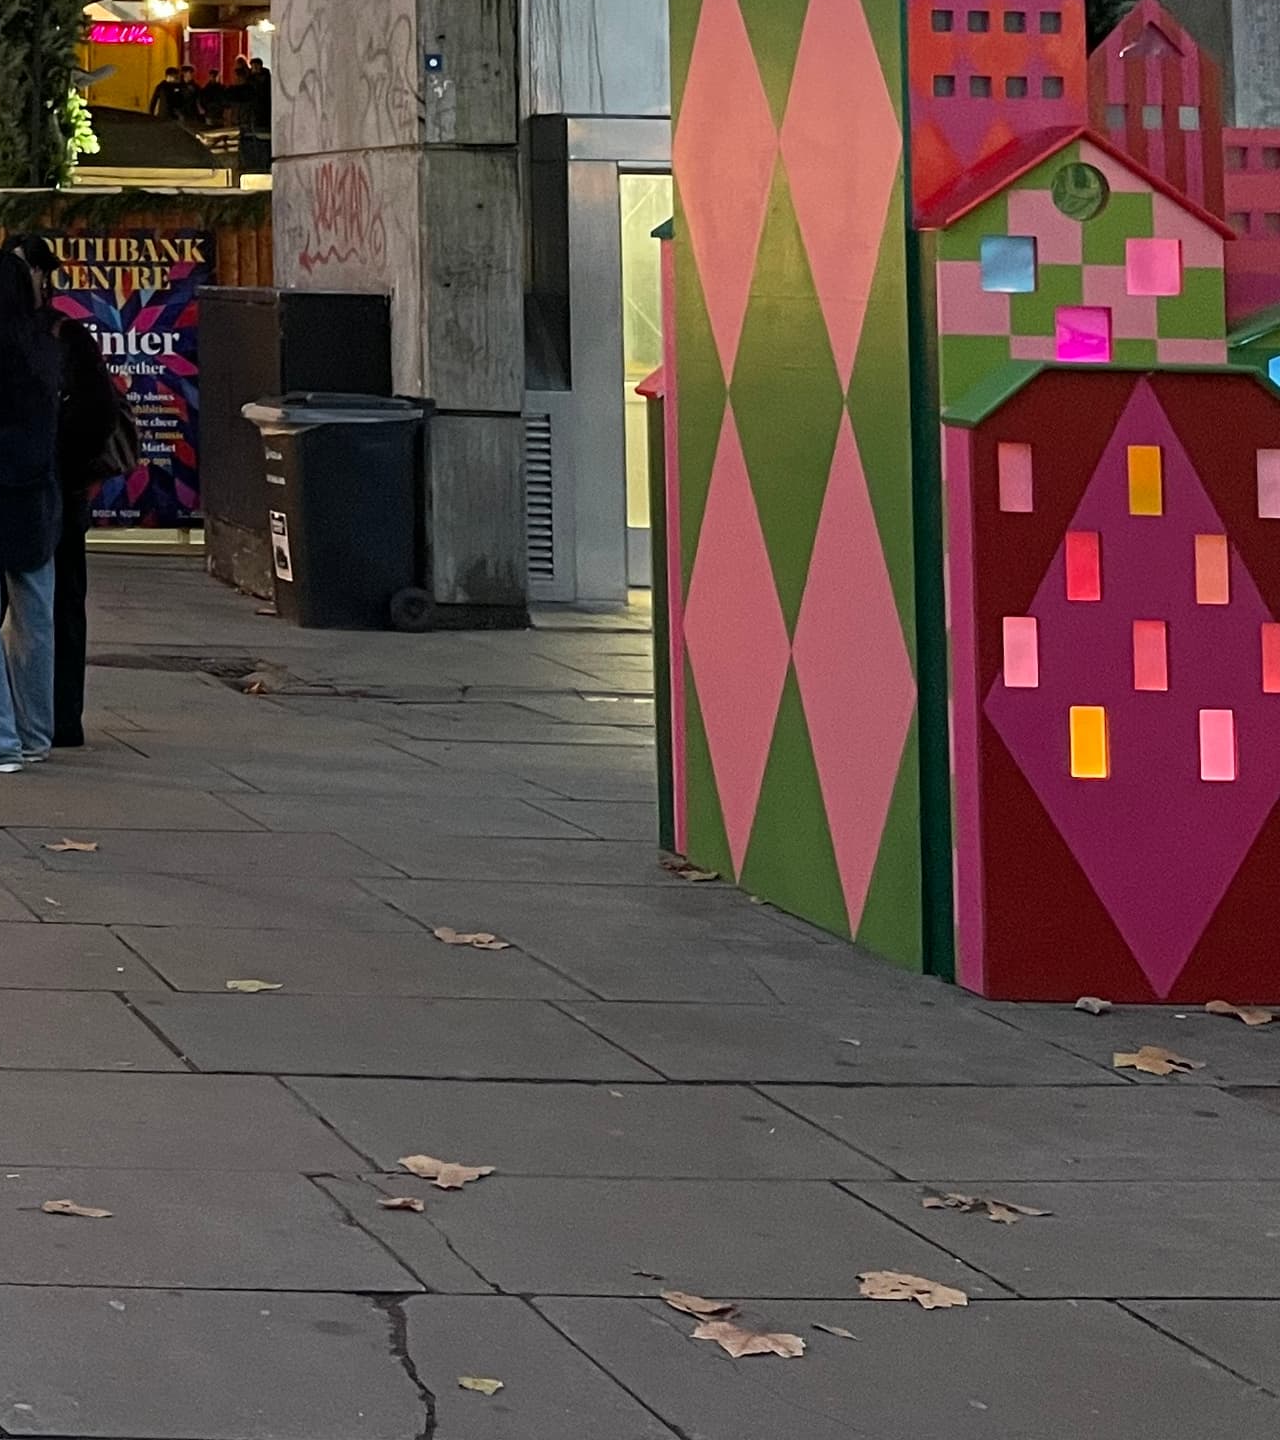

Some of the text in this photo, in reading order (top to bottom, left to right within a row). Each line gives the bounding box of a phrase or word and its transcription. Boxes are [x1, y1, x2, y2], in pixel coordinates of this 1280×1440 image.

[42, 237, 206, 263] UTHBANK
[51, 265, 171, 290] CENTRE
[83, 323, 180, 356] inter
